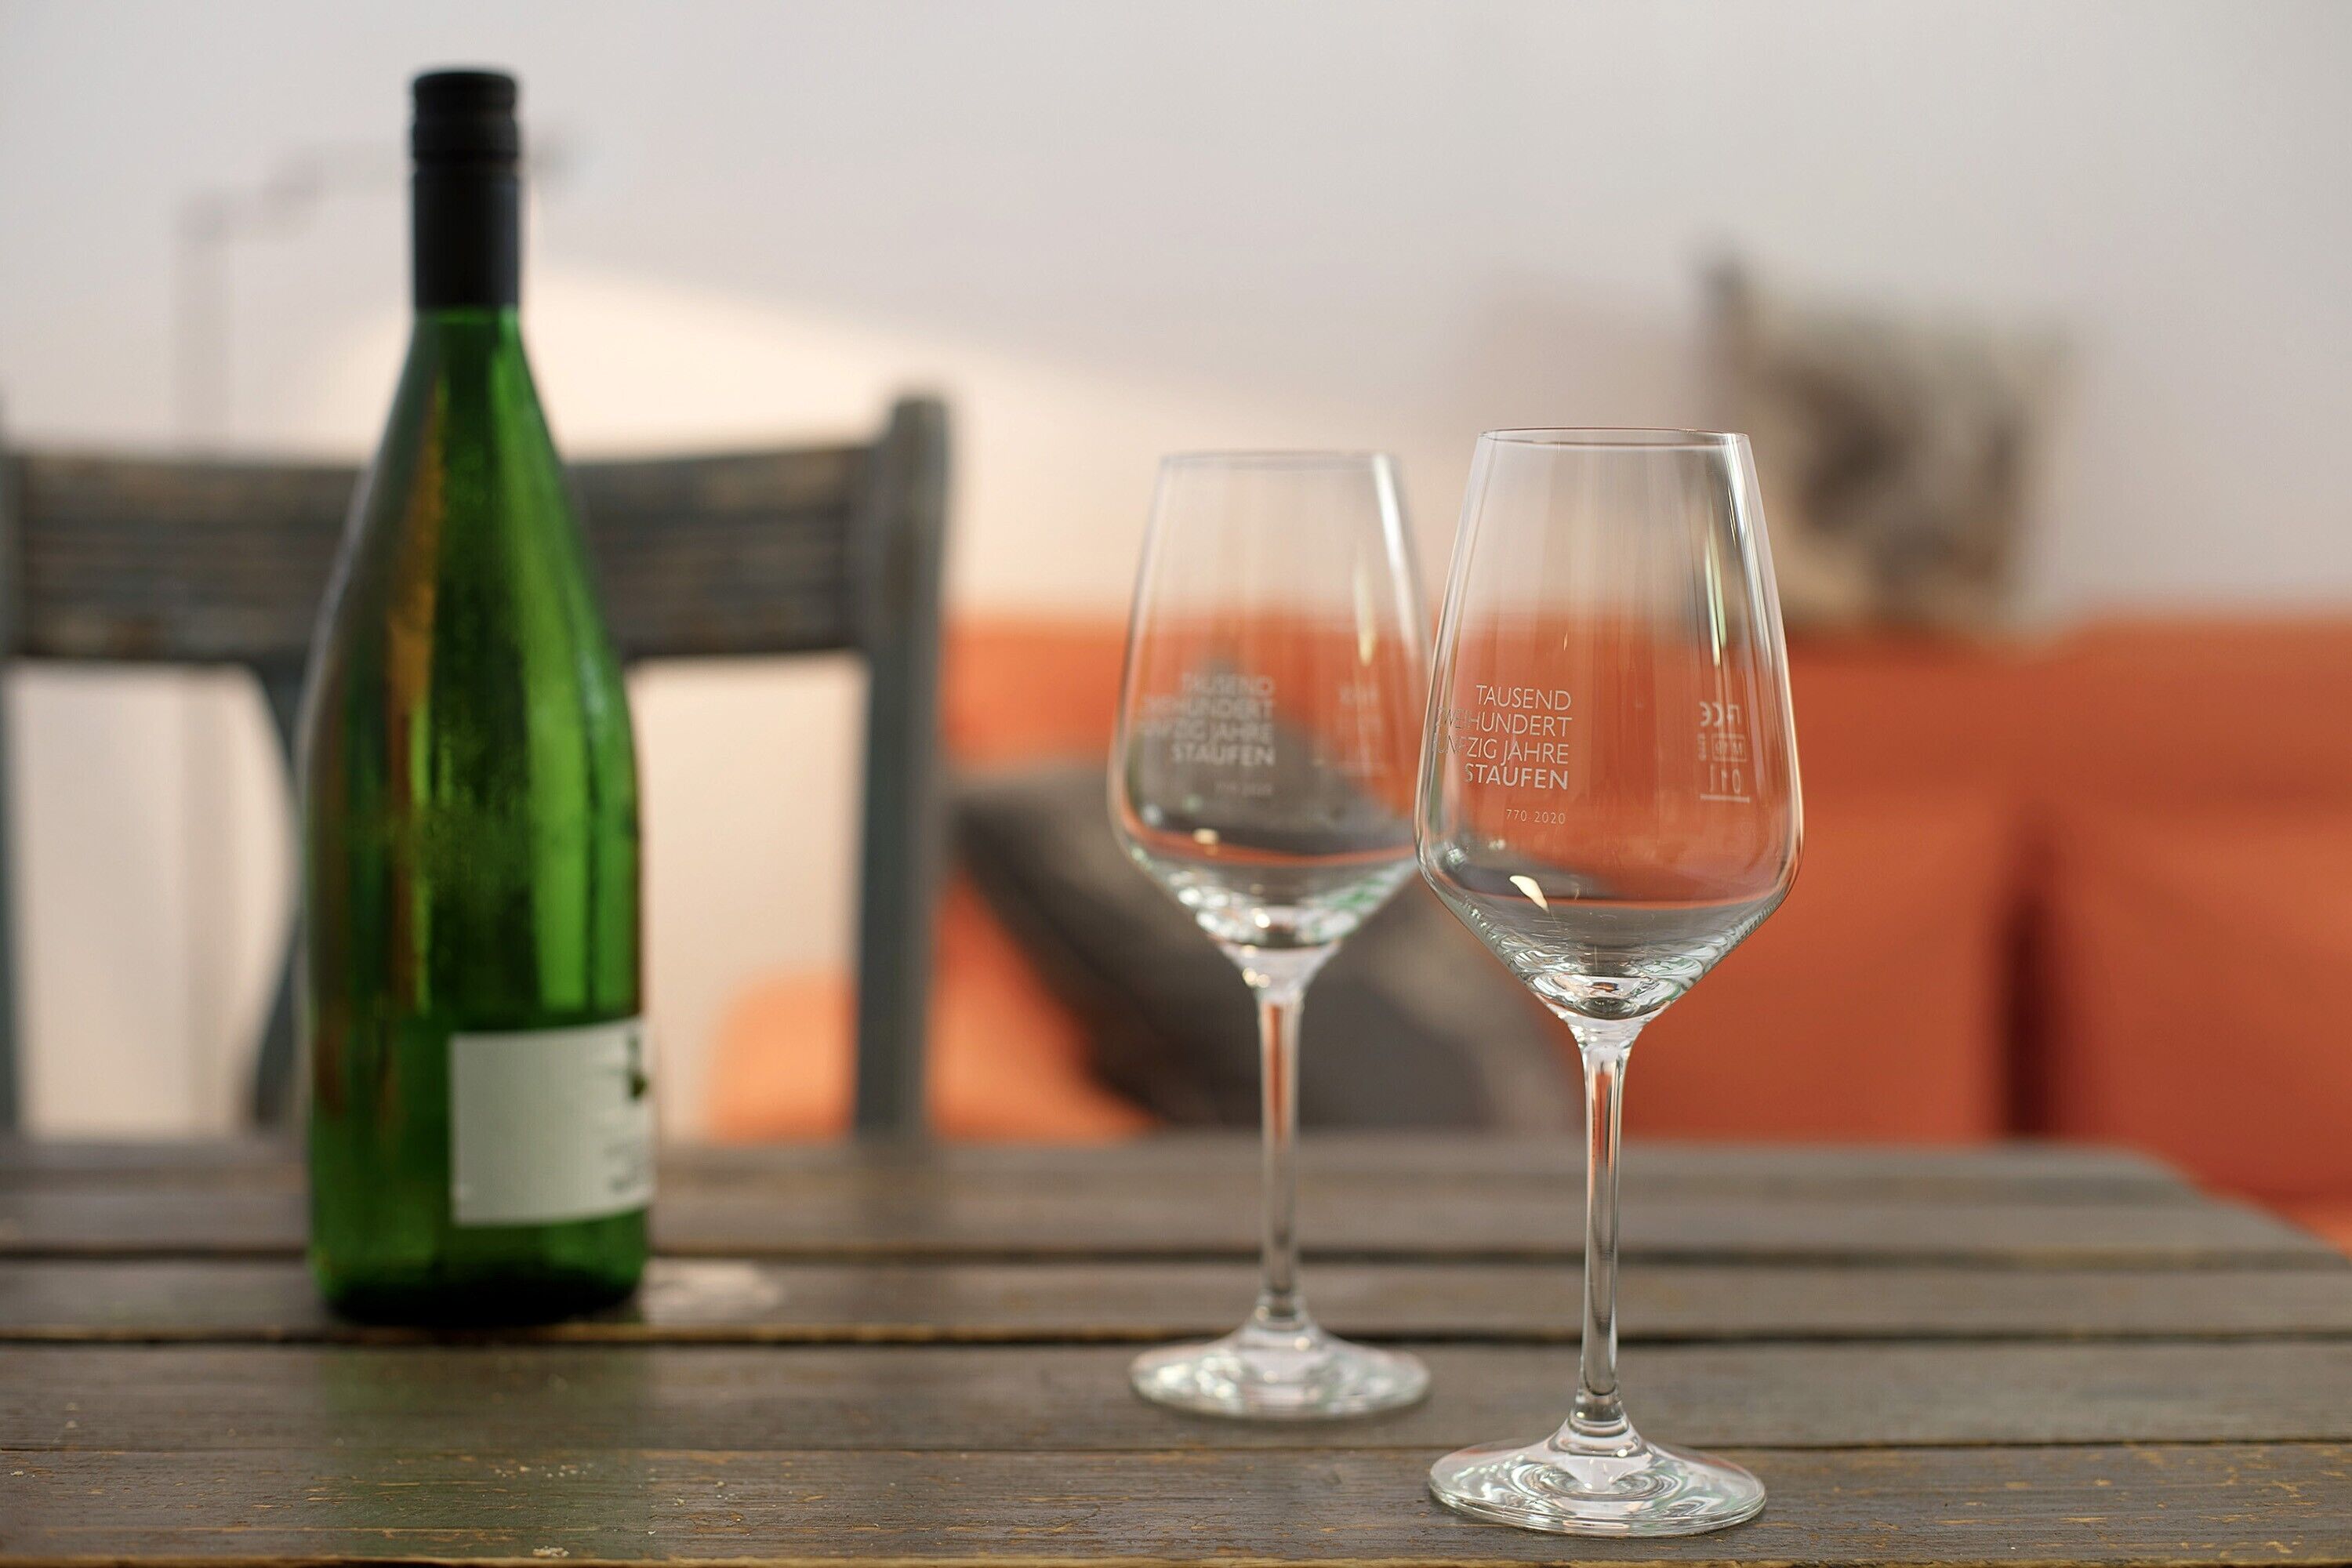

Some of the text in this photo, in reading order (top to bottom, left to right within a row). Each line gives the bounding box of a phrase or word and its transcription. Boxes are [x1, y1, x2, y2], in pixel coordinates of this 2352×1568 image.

[1476, 684, 1571, 711] TAUSEND
[1501, 740, 1569, 766] JAHRE
[1465, 763, 1568, 790] STAUFEN
